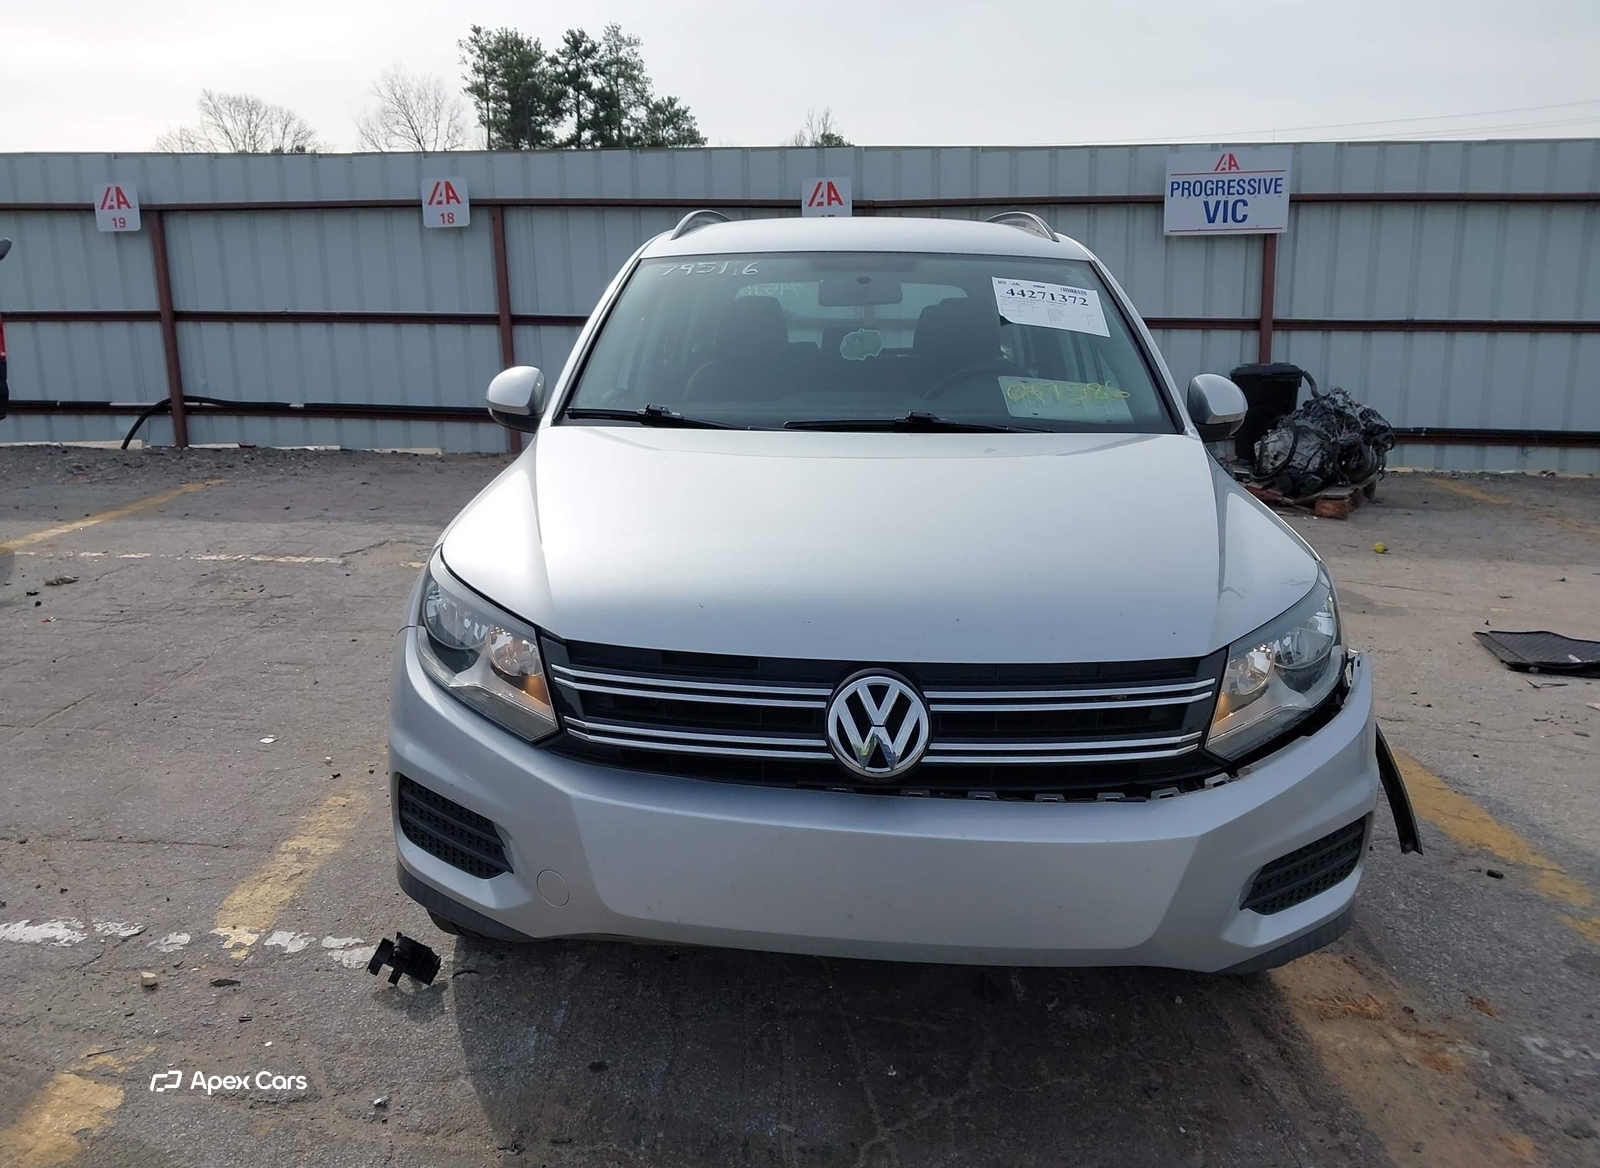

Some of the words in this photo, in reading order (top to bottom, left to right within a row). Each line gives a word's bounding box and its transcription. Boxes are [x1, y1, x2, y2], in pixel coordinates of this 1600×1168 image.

[1170, 178, 1284, 197] PROGRESSIVE
[439, 212, 455, 224] 18
[1203, 199, 1249, 224] VIC
[111, 217, 126, 228] 19
[1006, 288, 1089, 306] 44271372
